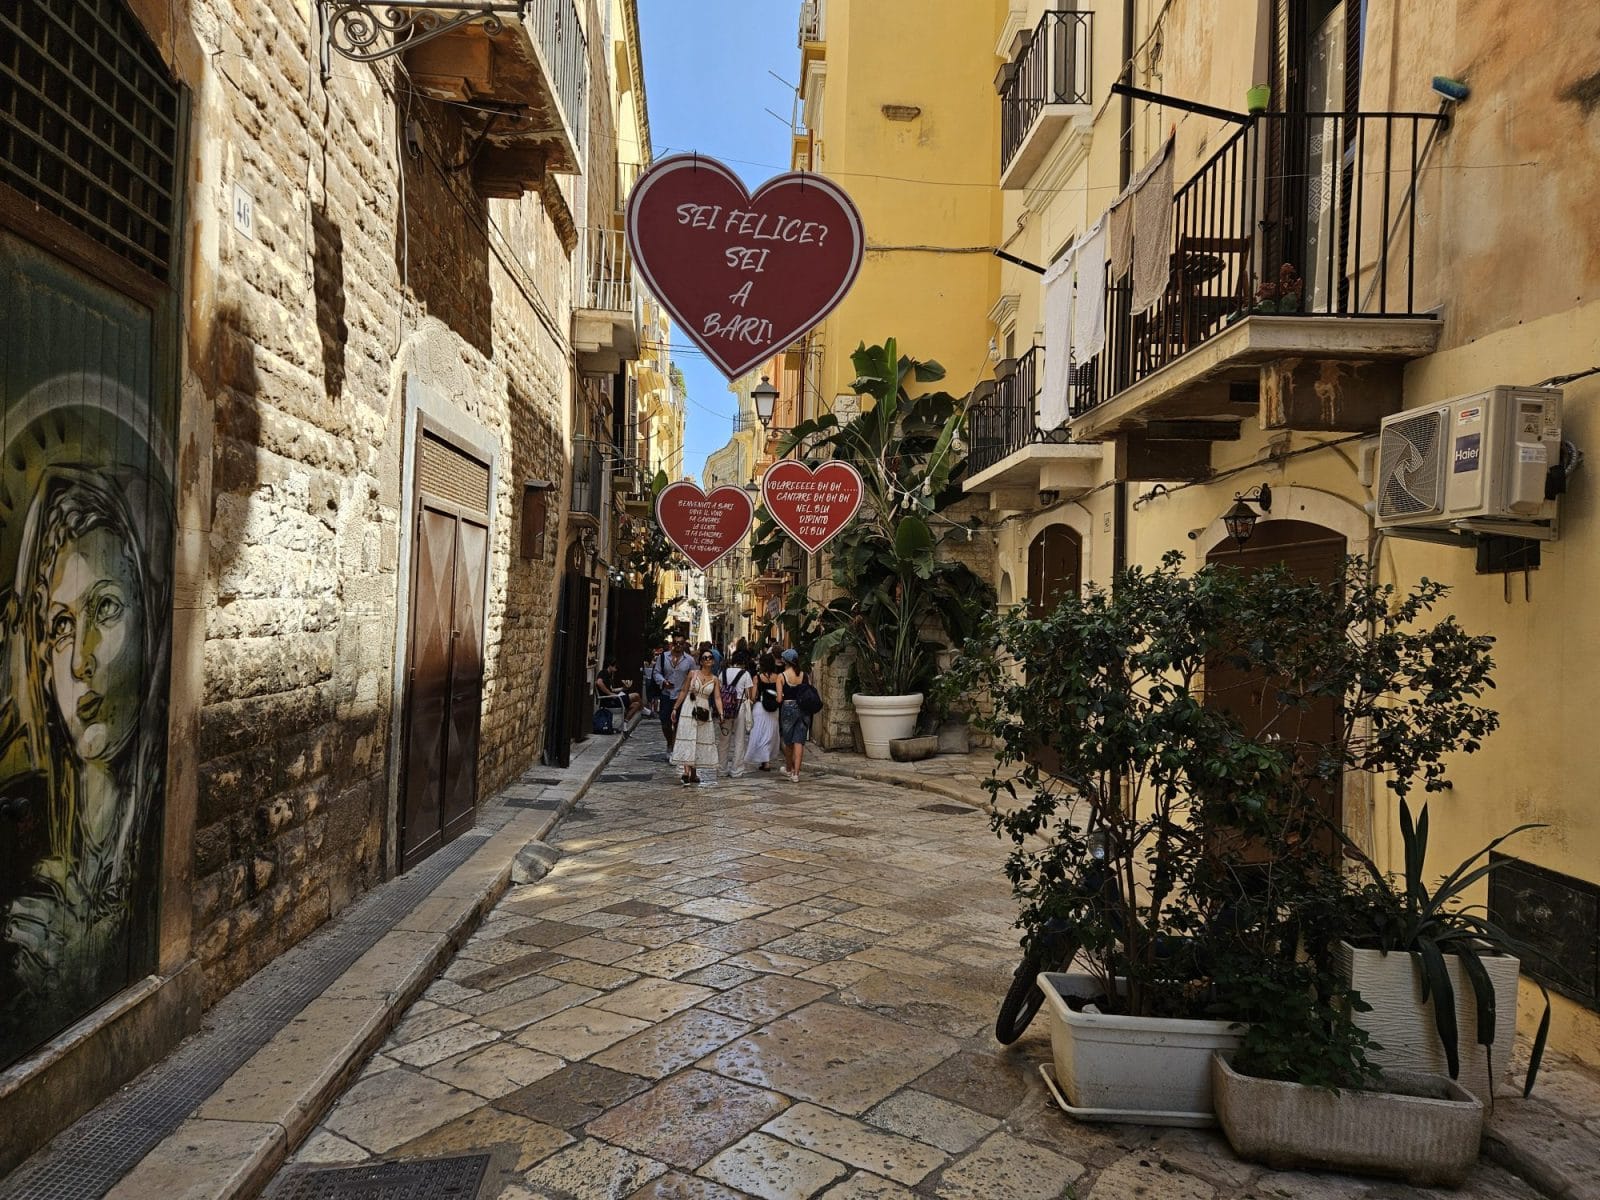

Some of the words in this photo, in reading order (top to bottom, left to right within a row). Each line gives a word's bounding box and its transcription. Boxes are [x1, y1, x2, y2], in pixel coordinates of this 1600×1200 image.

[237, 198, 249, 228] 46
[676, 203, 722, 230] SEI
[725, 209, 828, 247] FELICE?
[725, 247, 770, 272] SEI
[729, 281, 754, 307] A
[702, 312, 773, 345] BARI!
[1456, 448, 1478, 460] Haier
[776, 492, 812, 502] CANTARE
[796, 504, 812, 512] NEL
[815, 505, 830, 513] BLU
[800, 515, 828, 524] DIPINTO
[811, 527, 825, 535] BLU
